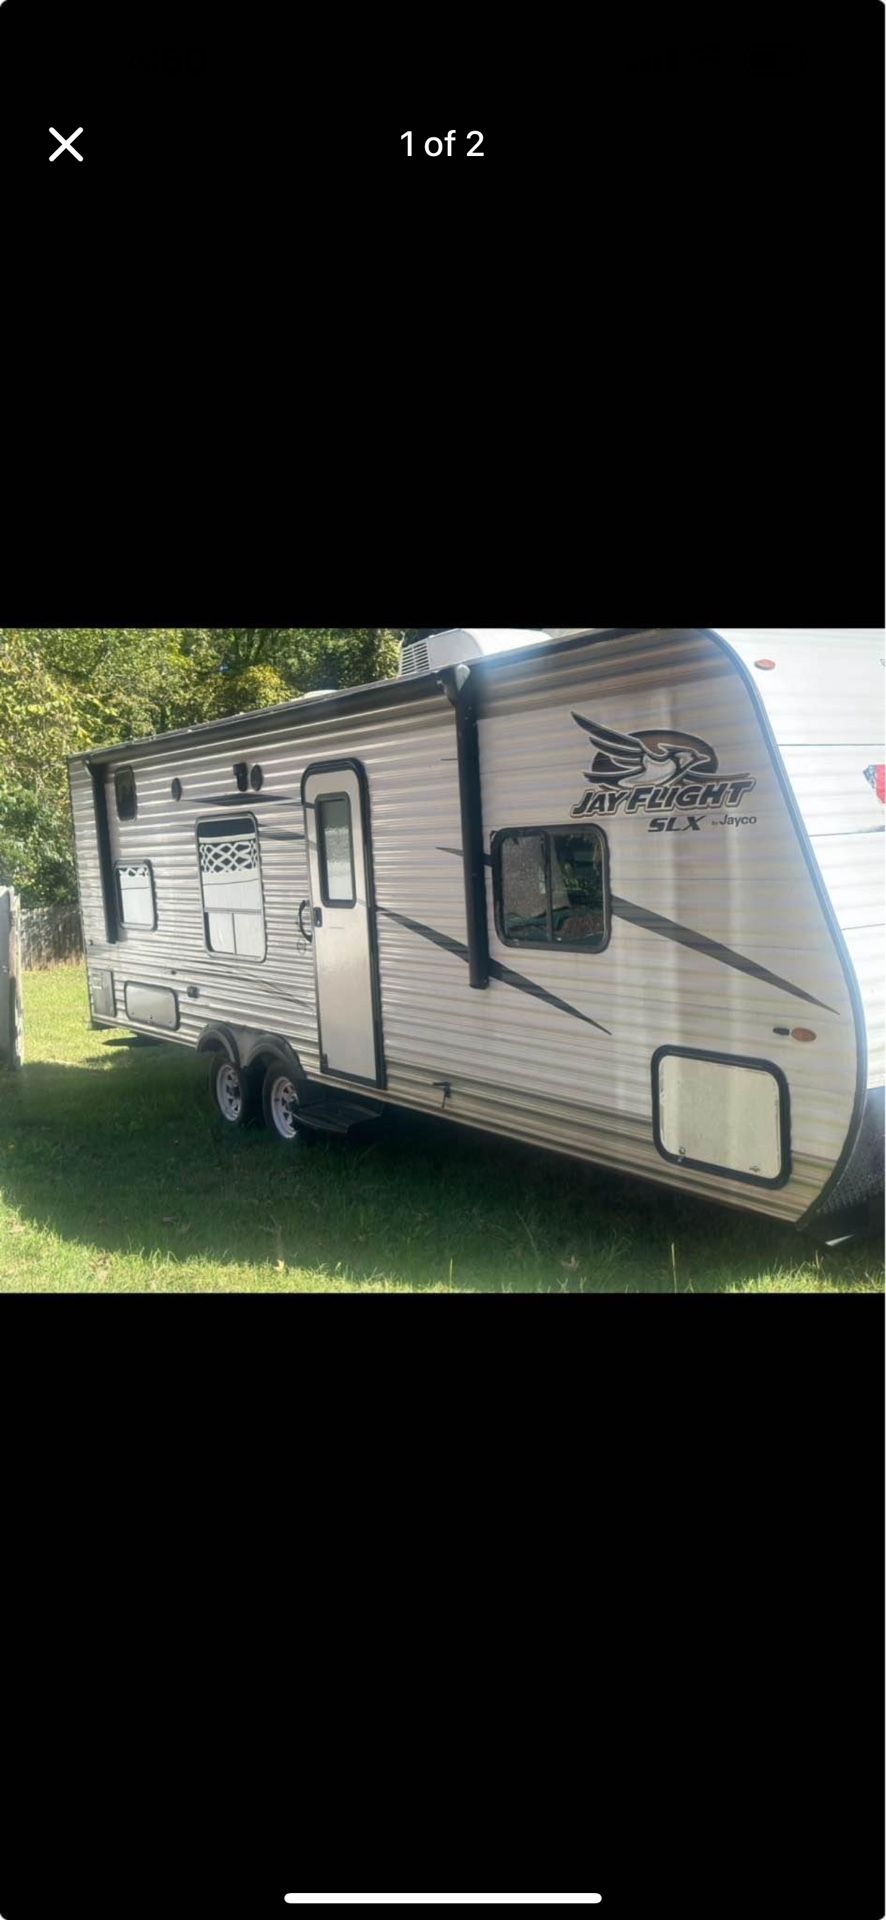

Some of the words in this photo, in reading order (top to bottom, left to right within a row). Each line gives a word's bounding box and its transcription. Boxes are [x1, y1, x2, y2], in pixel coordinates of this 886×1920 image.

[572, 790, 627, 818] JAY
[625, 779, 755, 814] FLIGHT
[648, 816, 706, 833] SLX
[719, 814, 757, 828] Jayco
